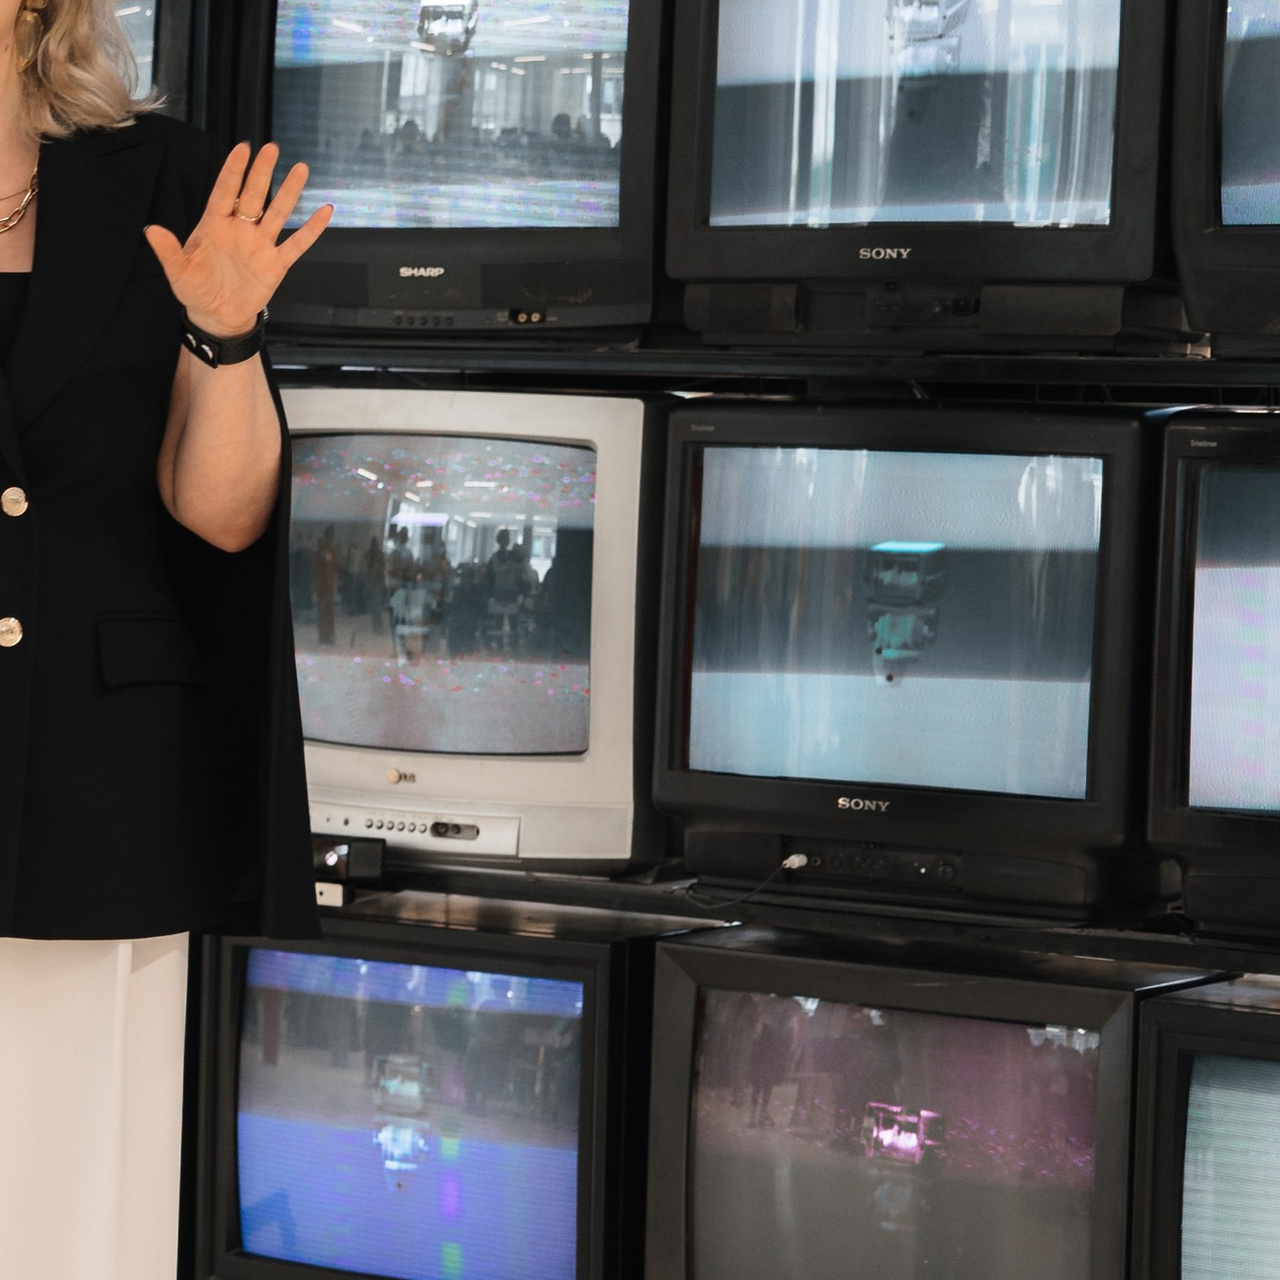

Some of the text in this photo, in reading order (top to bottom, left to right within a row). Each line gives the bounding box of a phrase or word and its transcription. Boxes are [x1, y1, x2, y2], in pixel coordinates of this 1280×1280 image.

[859, 248, 912, 260] SONY
[399, 266, 445, 278] SHARP
[837, 797, 890, 812] SONY
